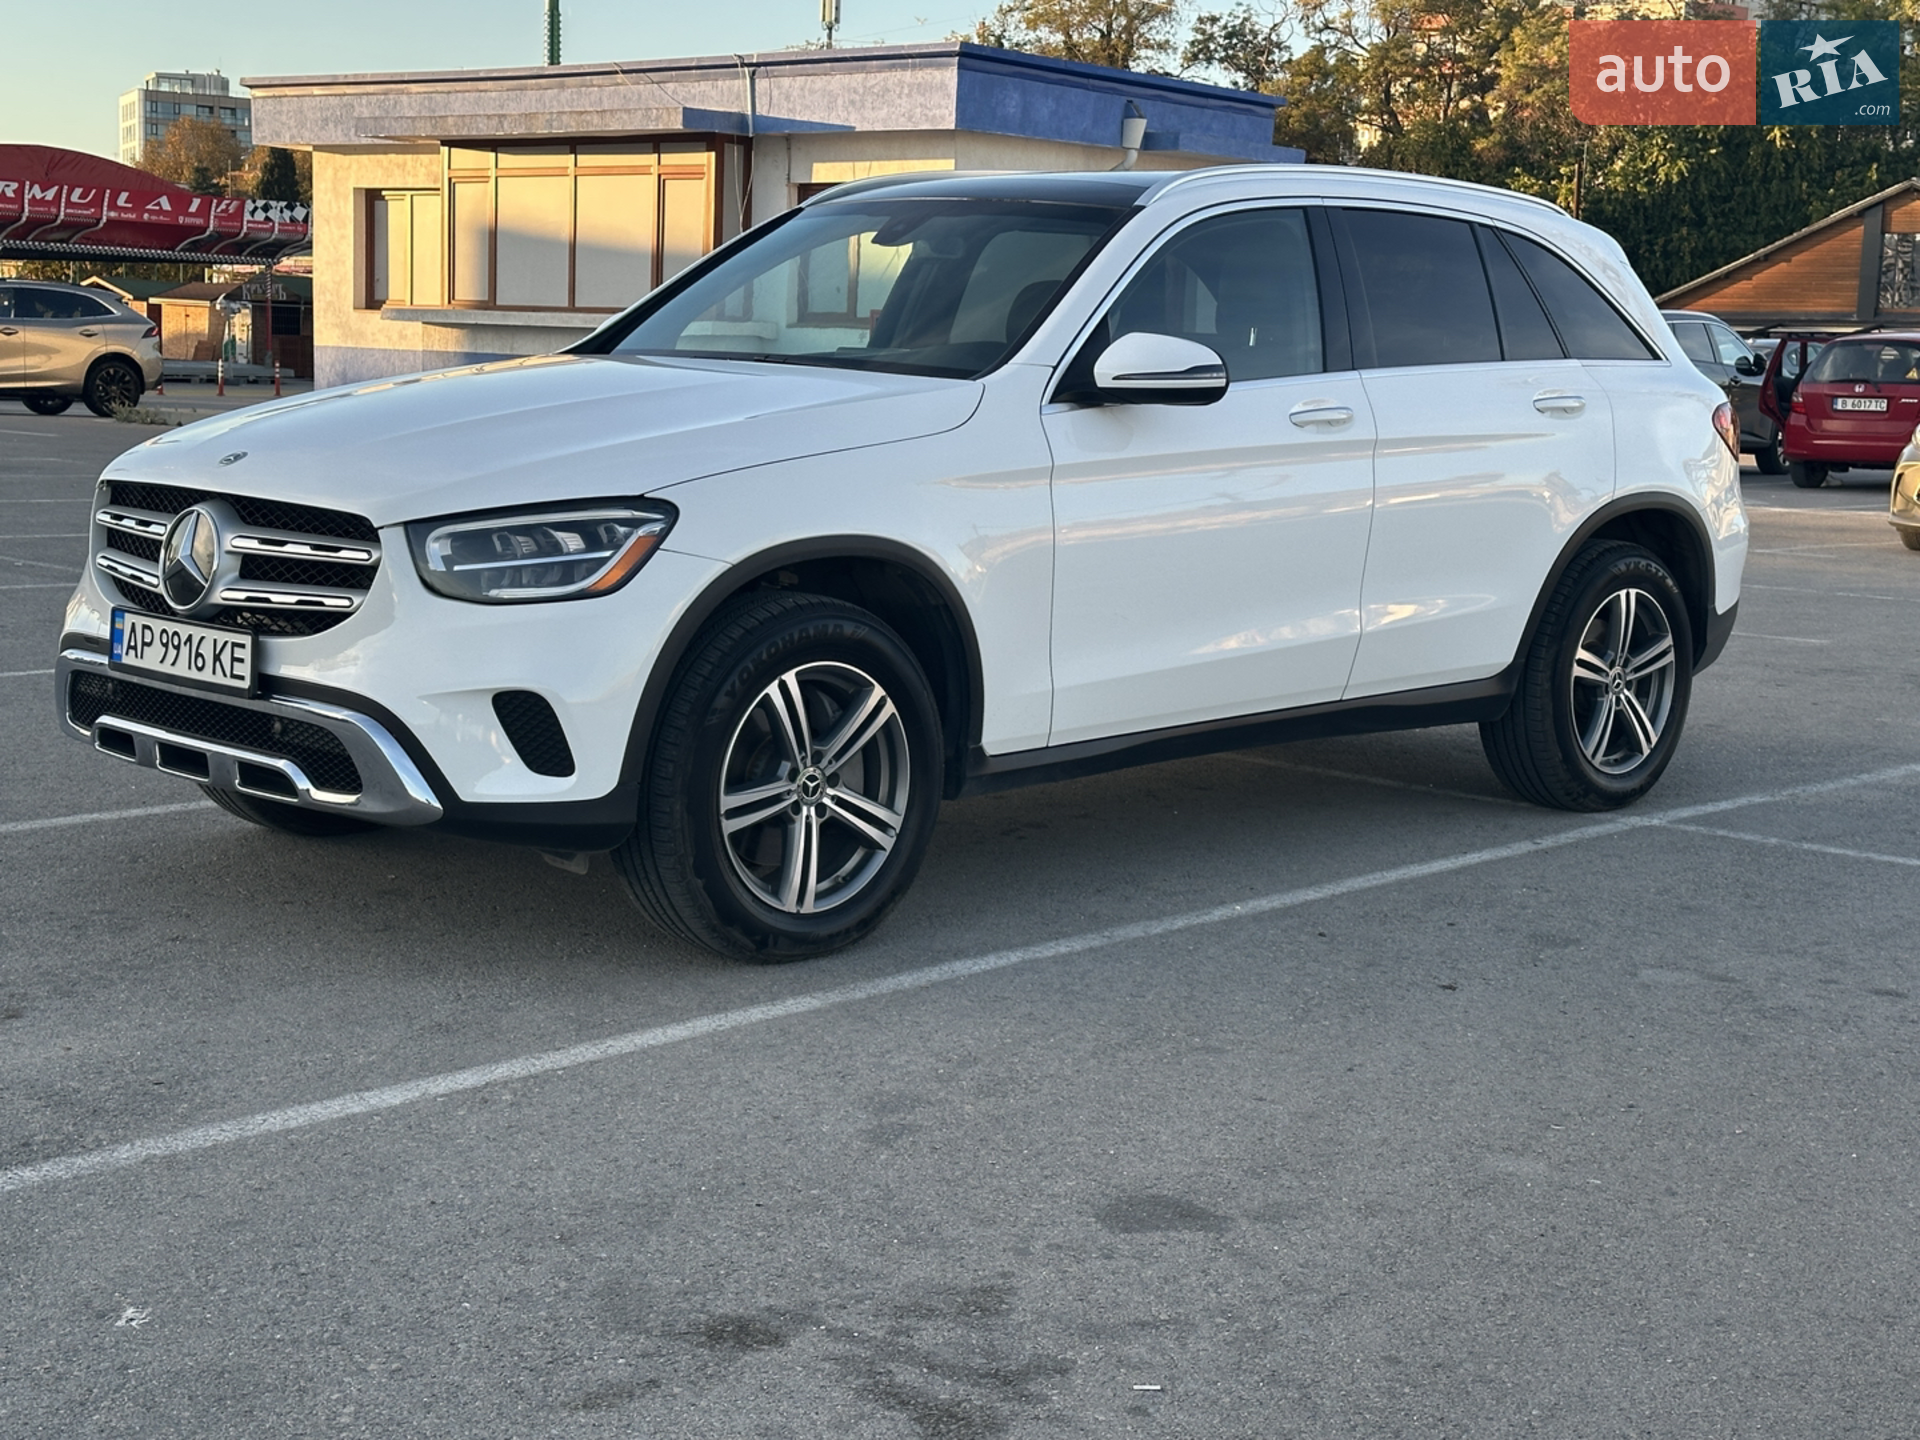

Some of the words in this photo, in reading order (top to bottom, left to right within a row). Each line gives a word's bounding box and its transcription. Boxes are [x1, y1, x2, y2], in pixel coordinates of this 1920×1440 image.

[1840, 399, 1848, 409] B
[1851, 399, 1873, 409] 6017
[1874, 399, 1886, 410] TC
[125, 621, 154, 660] AP
[158, 627, 207, 672] 9916
[212, 638, 247, 681] KE
[725, 623, 848, 702] YOKOHAMA
